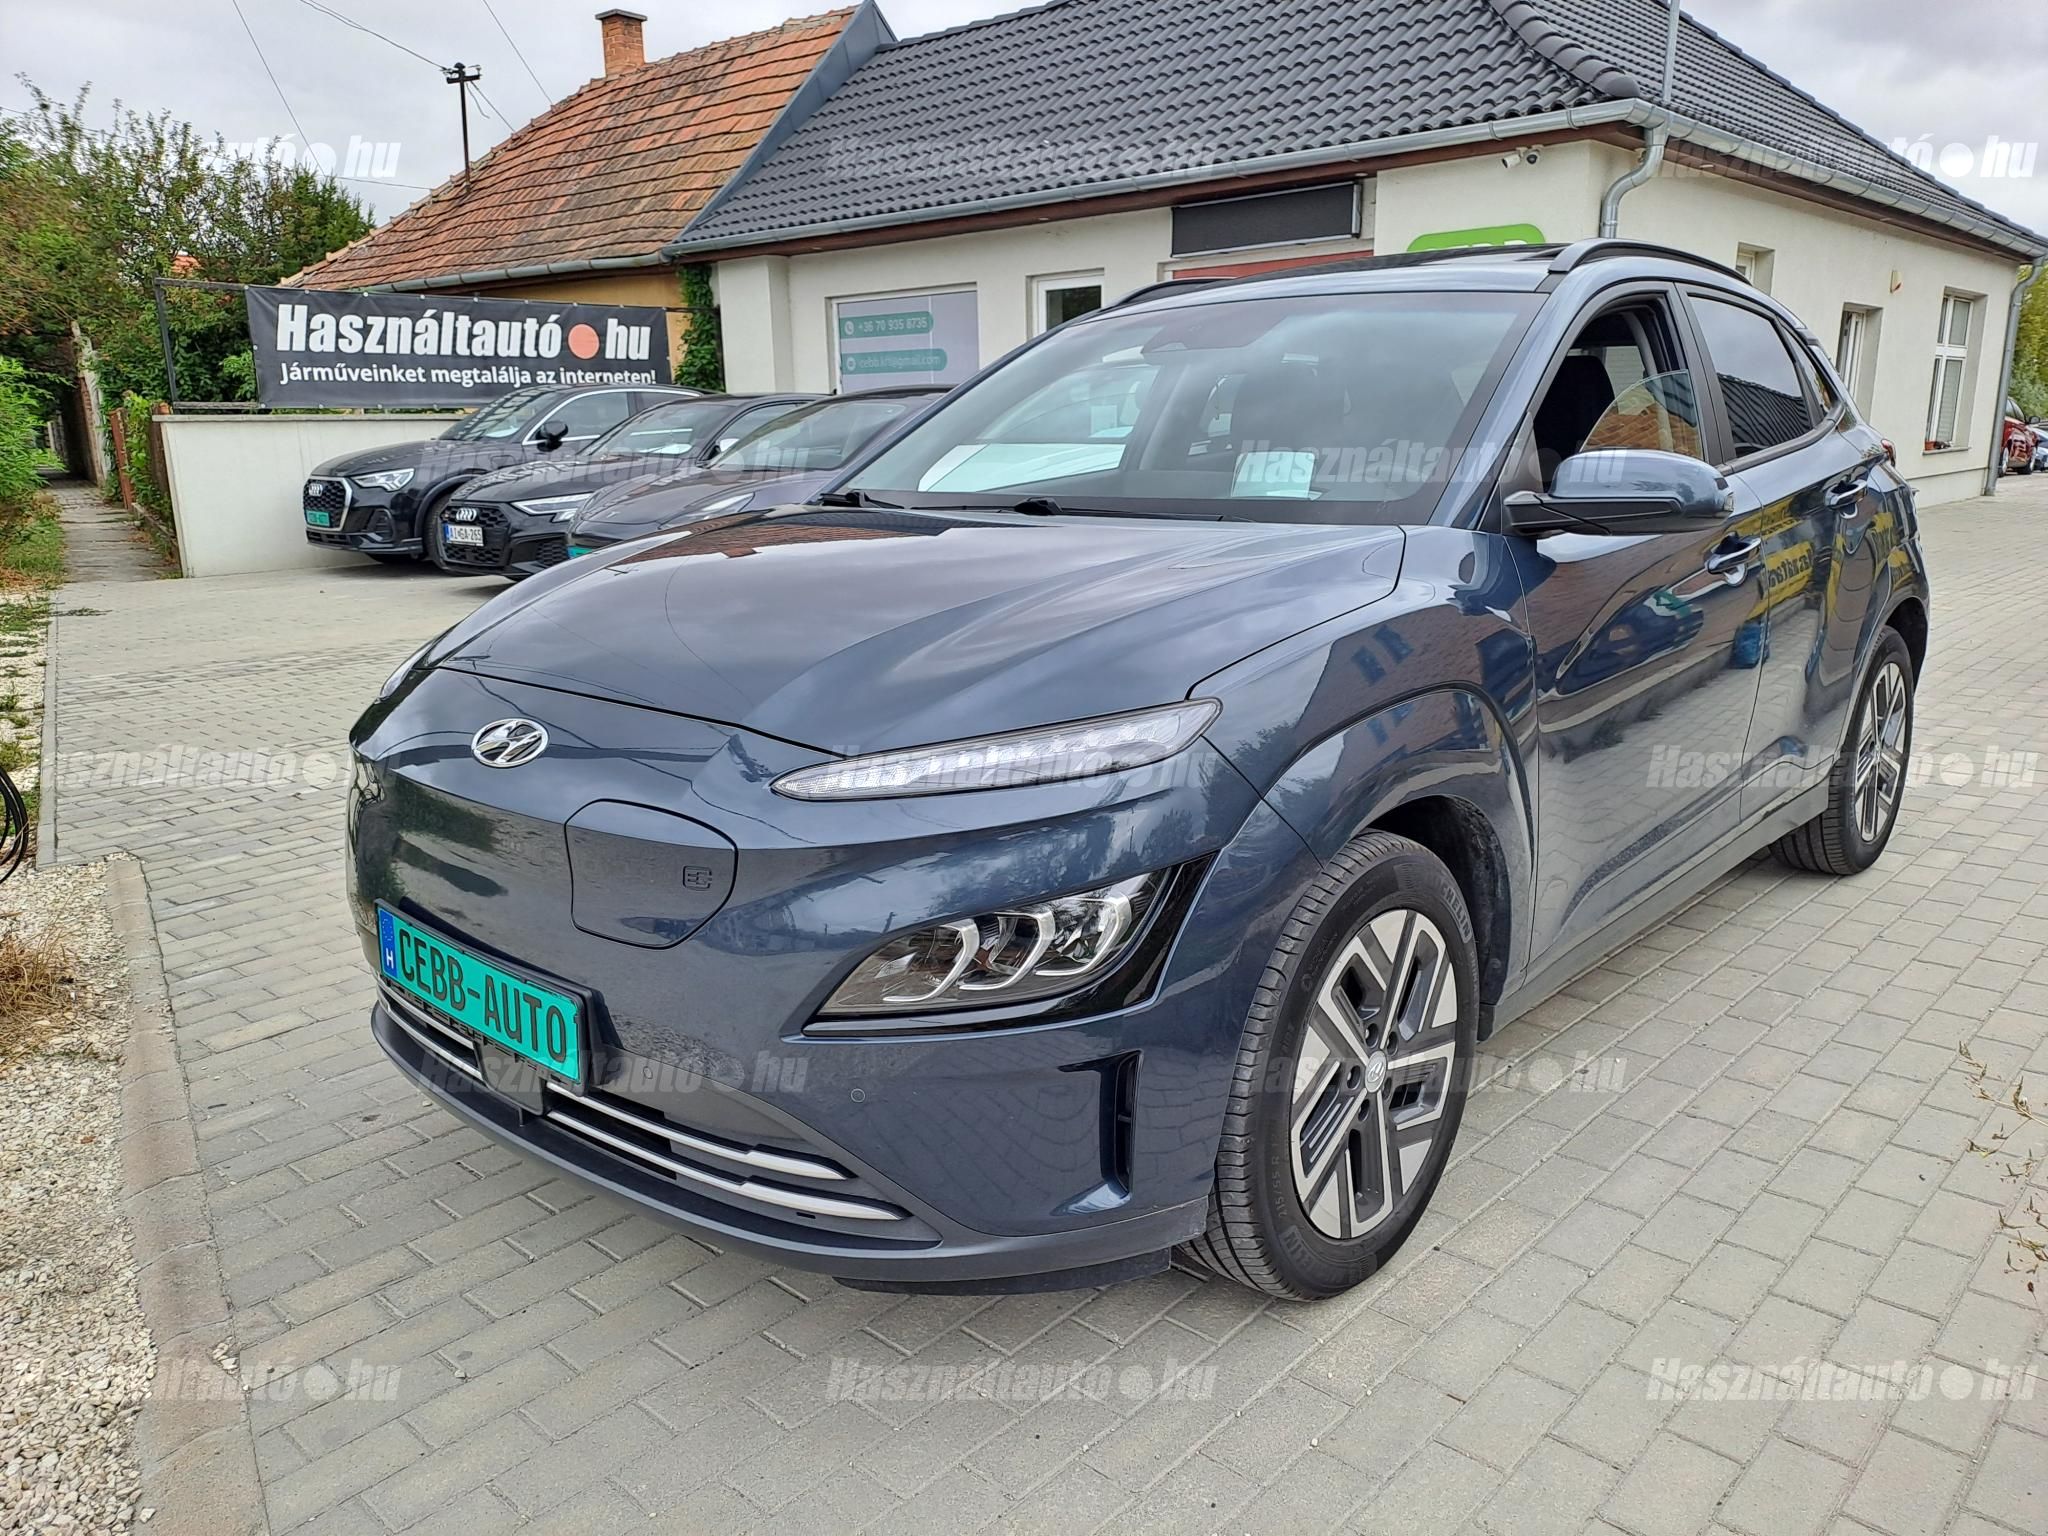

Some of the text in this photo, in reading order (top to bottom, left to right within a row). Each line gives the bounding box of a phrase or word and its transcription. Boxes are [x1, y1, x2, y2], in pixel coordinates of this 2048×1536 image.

[875, 319, 886, 332] 70
[280, 361, 657, 388] Járműveinket megtalálja az interneten!
[385, 947, 395, 969] H
[399, 928, 567, 1064] CEBB-AUTO
